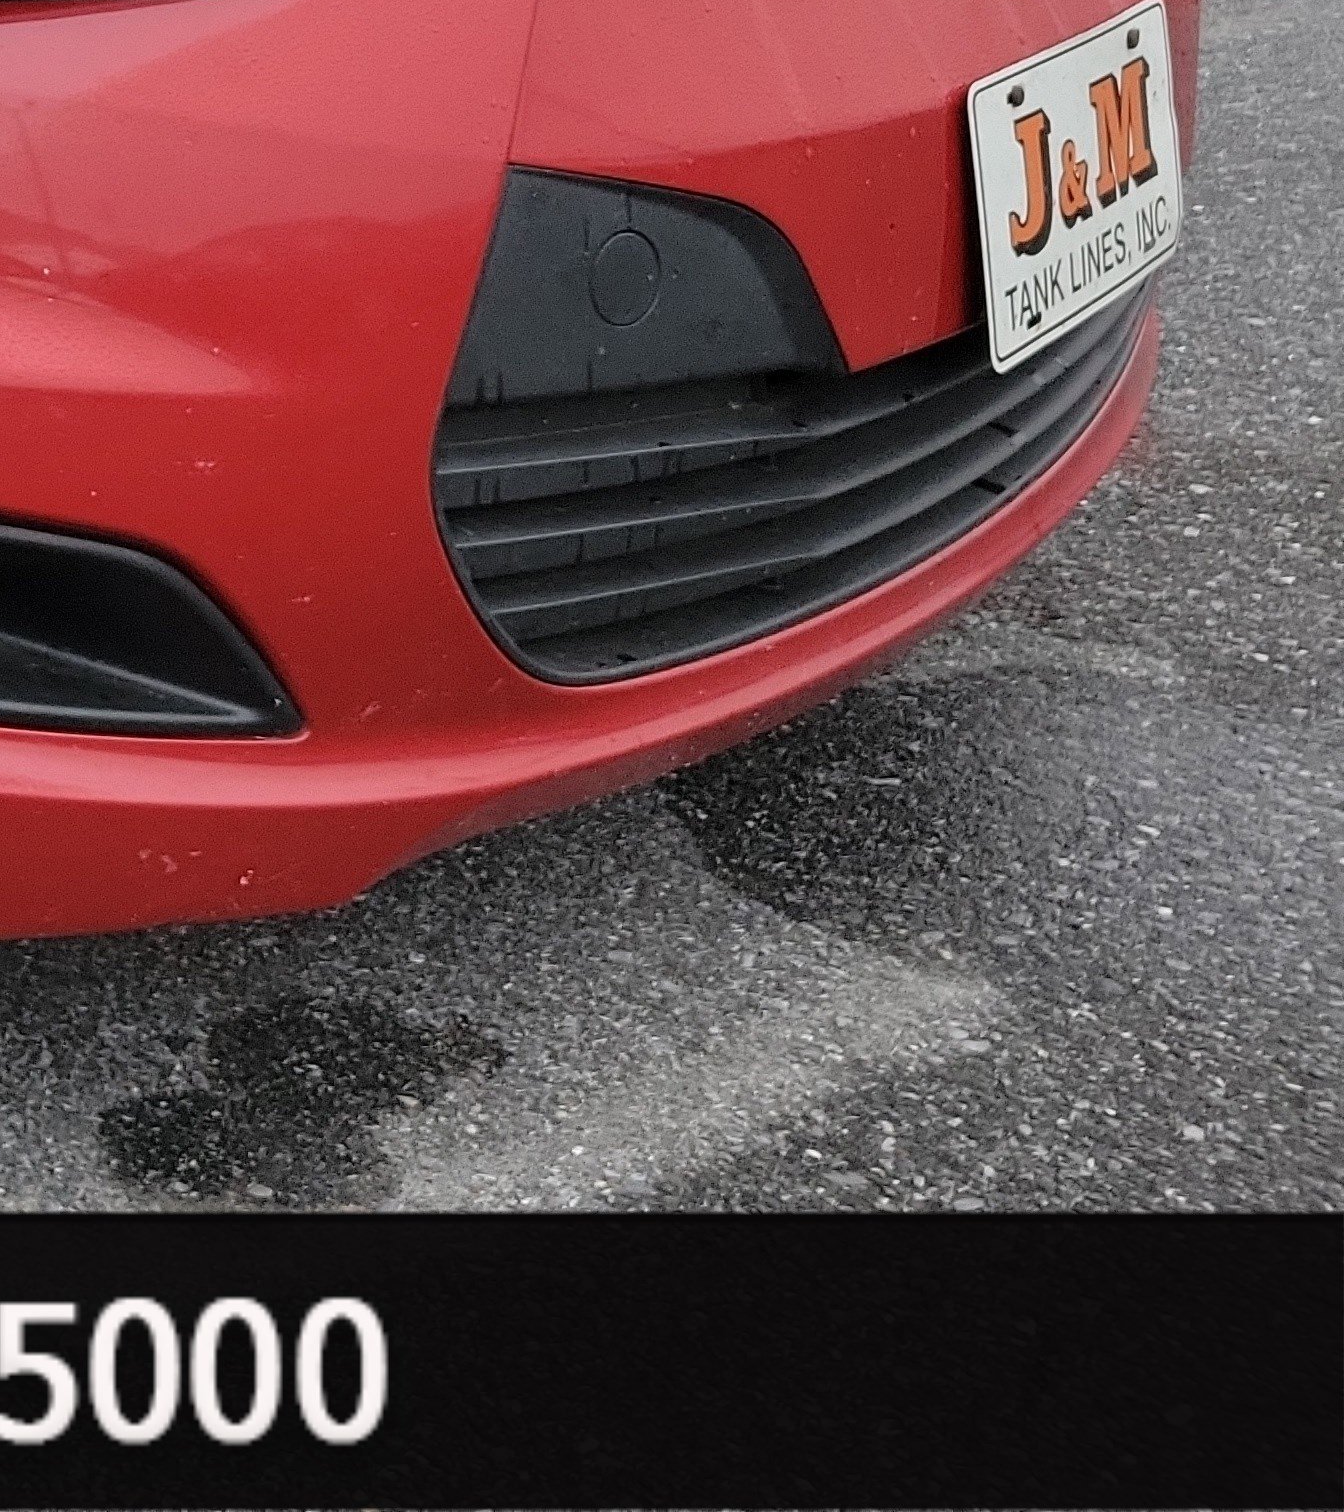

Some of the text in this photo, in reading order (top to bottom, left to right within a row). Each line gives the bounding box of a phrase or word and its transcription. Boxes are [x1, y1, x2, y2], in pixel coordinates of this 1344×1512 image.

[1004, 196, 1172, 332] TANK LINES, INC.
